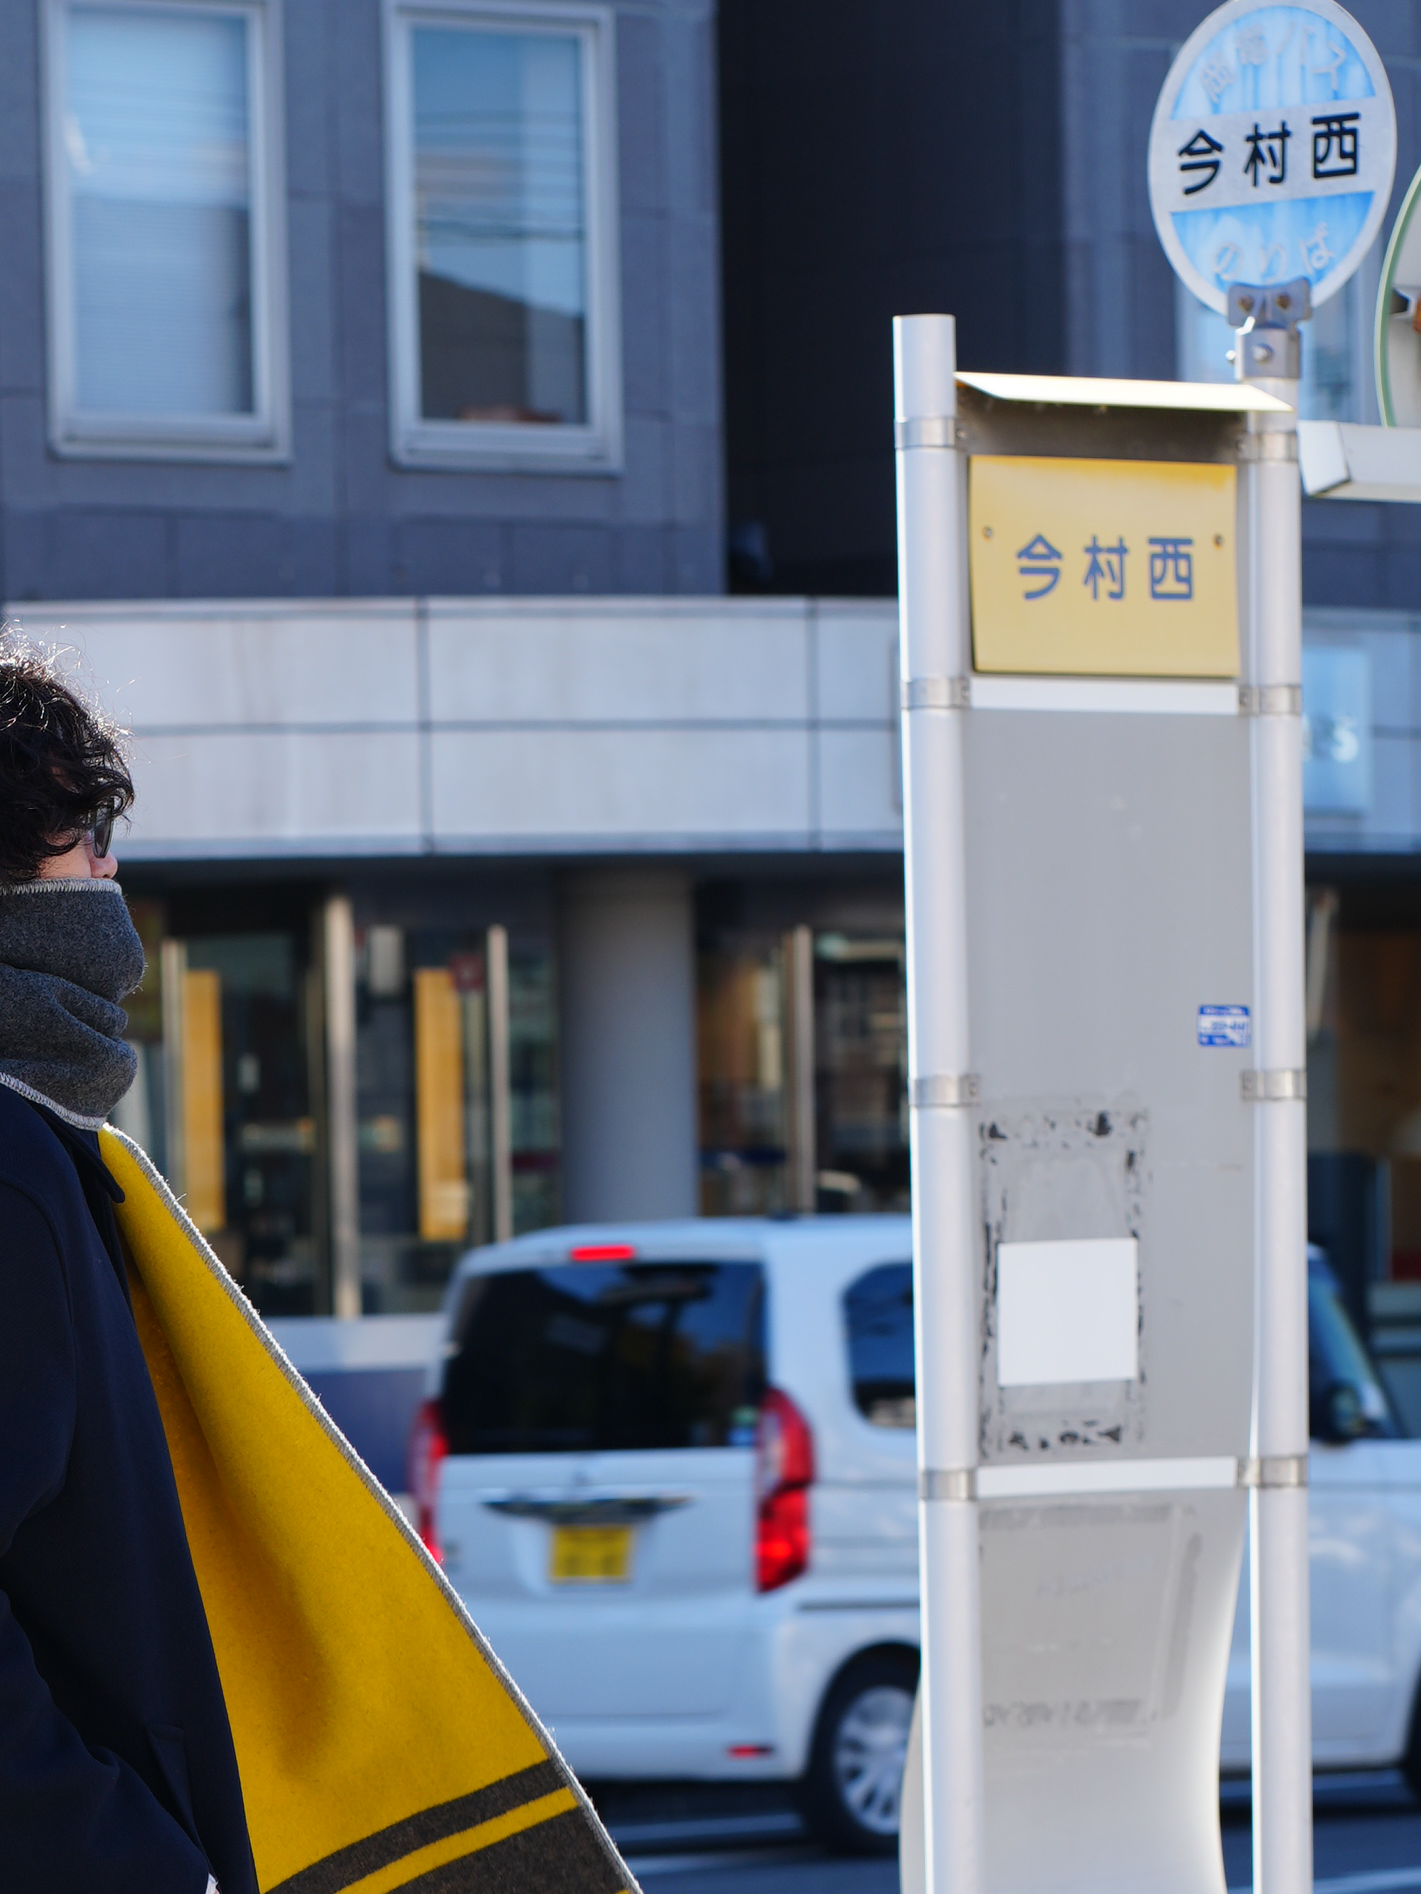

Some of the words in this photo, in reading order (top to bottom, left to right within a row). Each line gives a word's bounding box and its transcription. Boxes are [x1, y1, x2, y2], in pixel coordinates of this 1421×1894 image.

[1178, 112, 1361, 195] 今村西
[1213, 221, 1335, 282] のりば
[1016, 533, 1195, 601] 今村西
